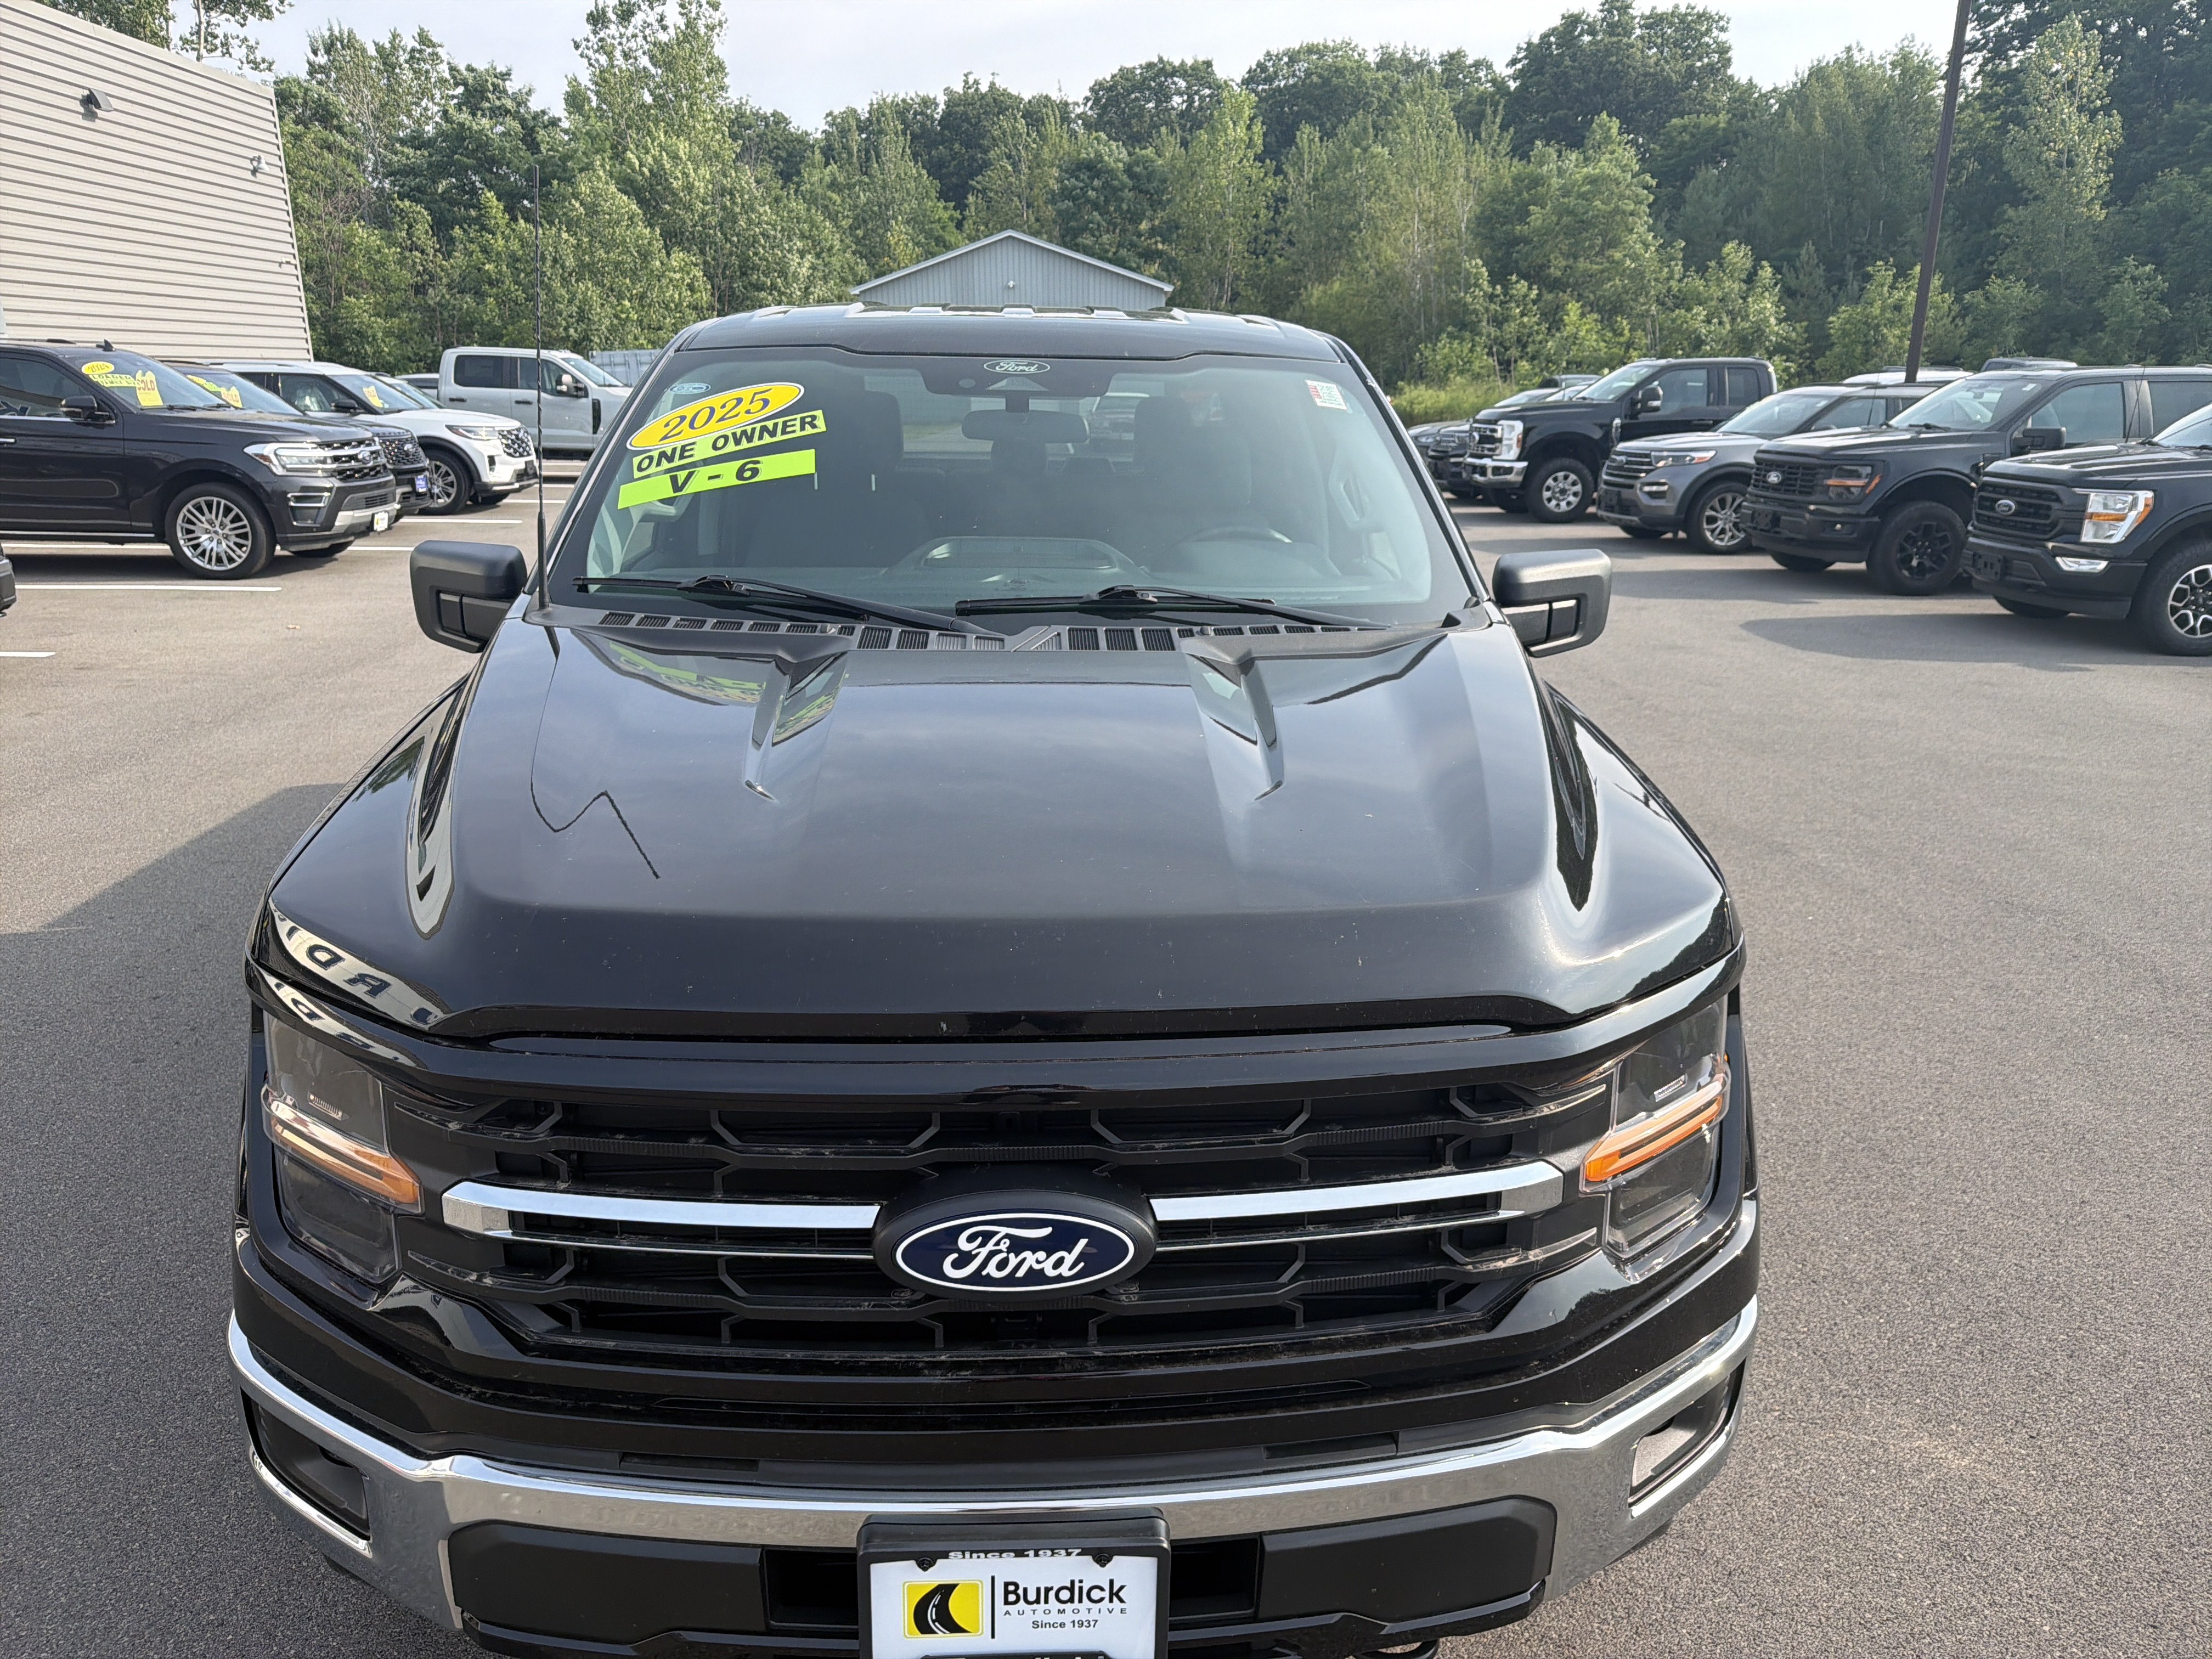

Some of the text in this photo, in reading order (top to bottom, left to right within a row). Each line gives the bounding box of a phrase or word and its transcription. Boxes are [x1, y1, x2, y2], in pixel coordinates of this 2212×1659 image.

[995, 361, 1039, 371] Ford
[137, 379, 155, 391] SOLD
[659, 388, 774, 443] 2025
[636, 414, 820, 473] ONE OWNER
[943, 1225, 1089, 1279] Ford
[948, 1549, 1082, 1559] Since 1937
[1003, 1578, 1127, 1606] Burdick
[1003, 1607, 1127, 1616] AUTOMOTIVE
[1031, 1619, 1099, 1629] Since 1937
